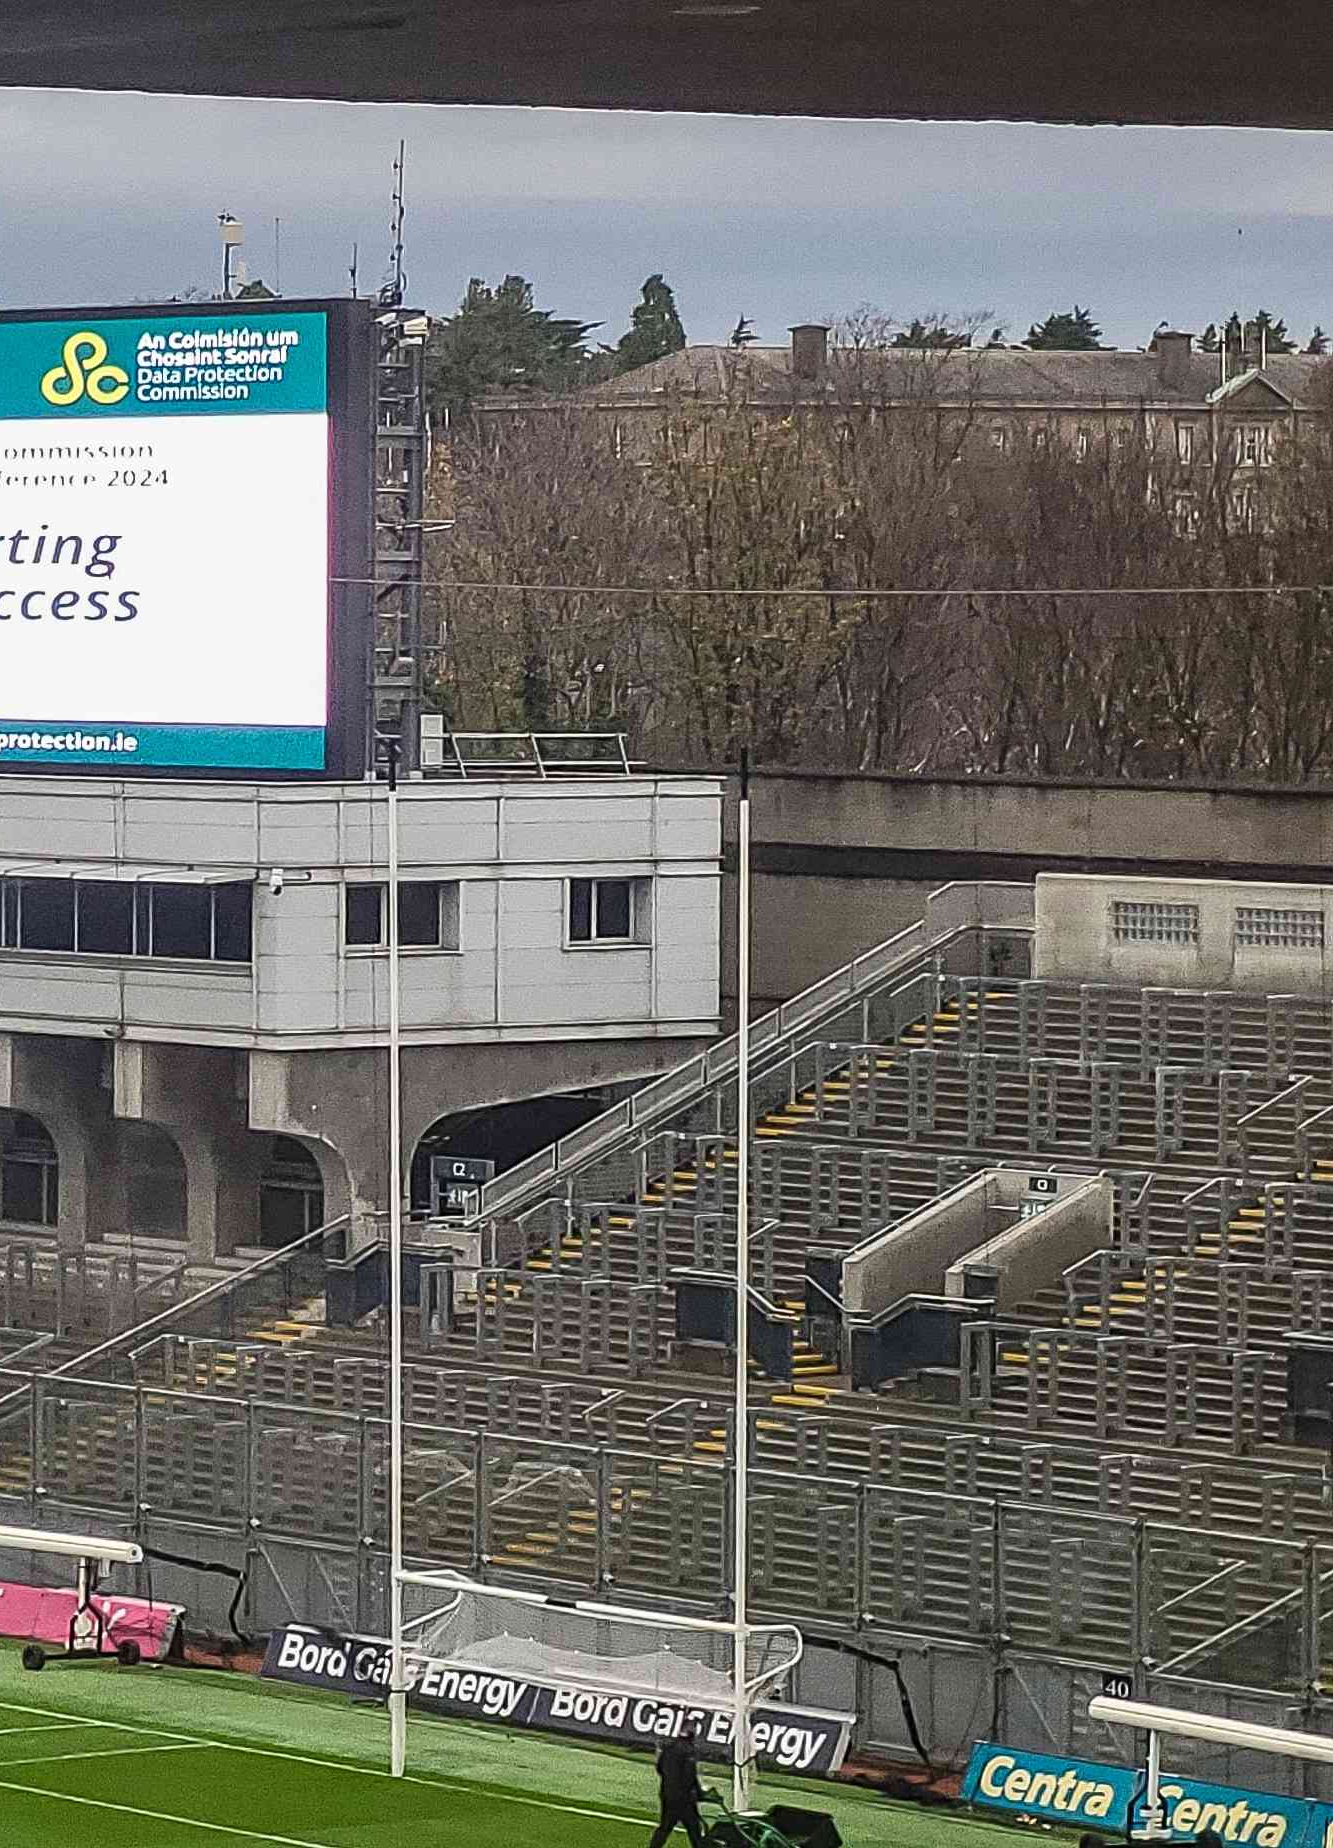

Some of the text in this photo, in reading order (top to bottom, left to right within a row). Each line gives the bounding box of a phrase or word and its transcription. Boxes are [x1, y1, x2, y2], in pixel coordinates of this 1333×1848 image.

[137, 332, 164, 349] An
[267, 330, 299, 346] um
[137, 348, 222, 368] Chosaint
[137, 366, 282, 384] Data Protection
[137, 383, 248, 402] Commission
[107, 469, 168, 487] 2024
[277, 1632, 351, 1678] Bord
[419, 1664, 528, 1717] Energy
[1104, 1678, 1130, 1699] 40
[550, 1686, 628, 1728] Bord
[979, 1755, 1115, 1818] Centra
